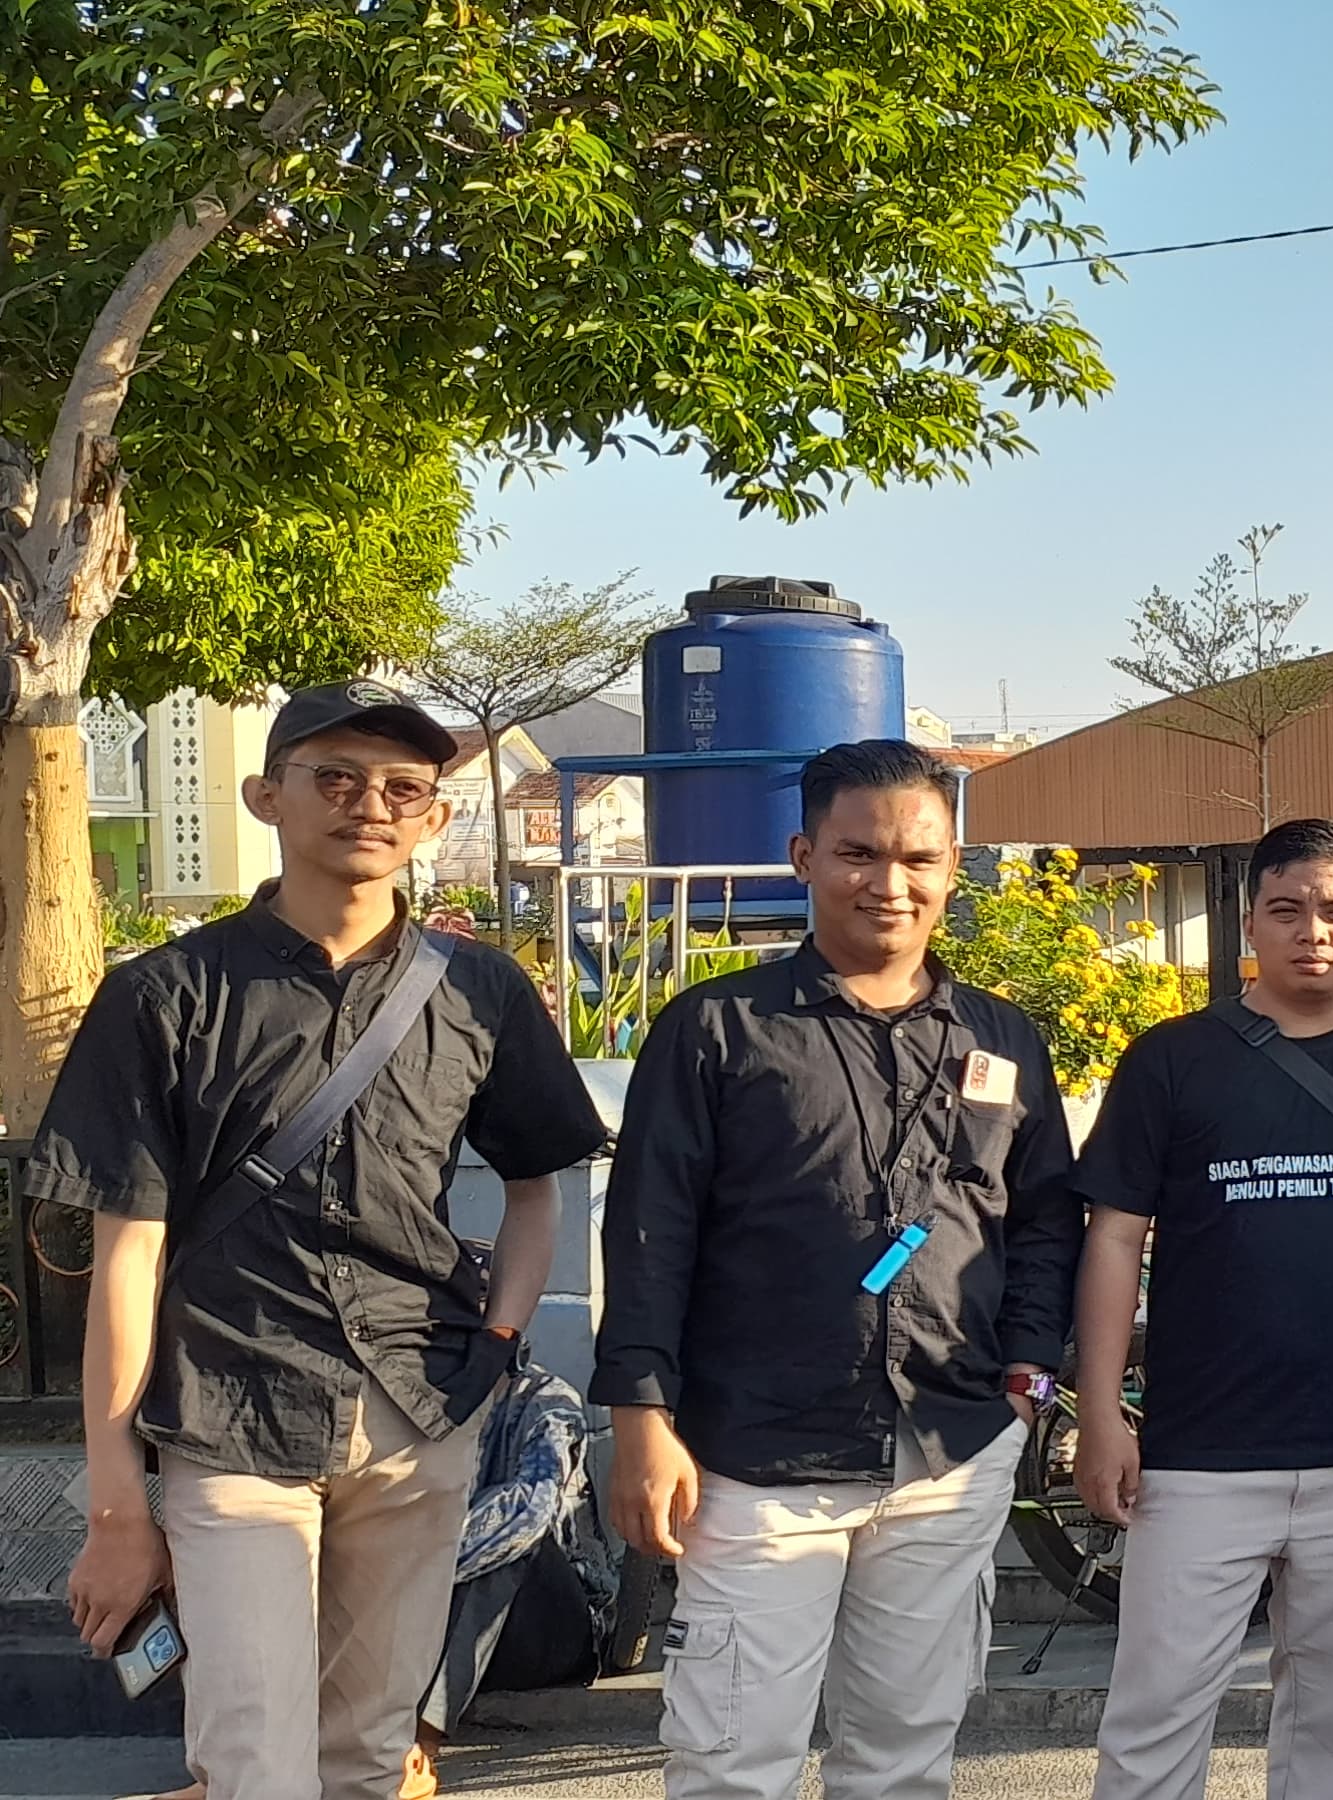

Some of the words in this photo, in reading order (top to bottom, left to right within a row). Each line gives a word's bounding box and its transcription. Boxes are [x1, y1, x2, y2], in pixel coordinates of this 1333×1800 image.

[1208, 1160, 1250, 1182] SIAGA
[1225, 1181, 1274, 1202] MENUJU
[1277, 1178, 1327, 1198] PEMILU
